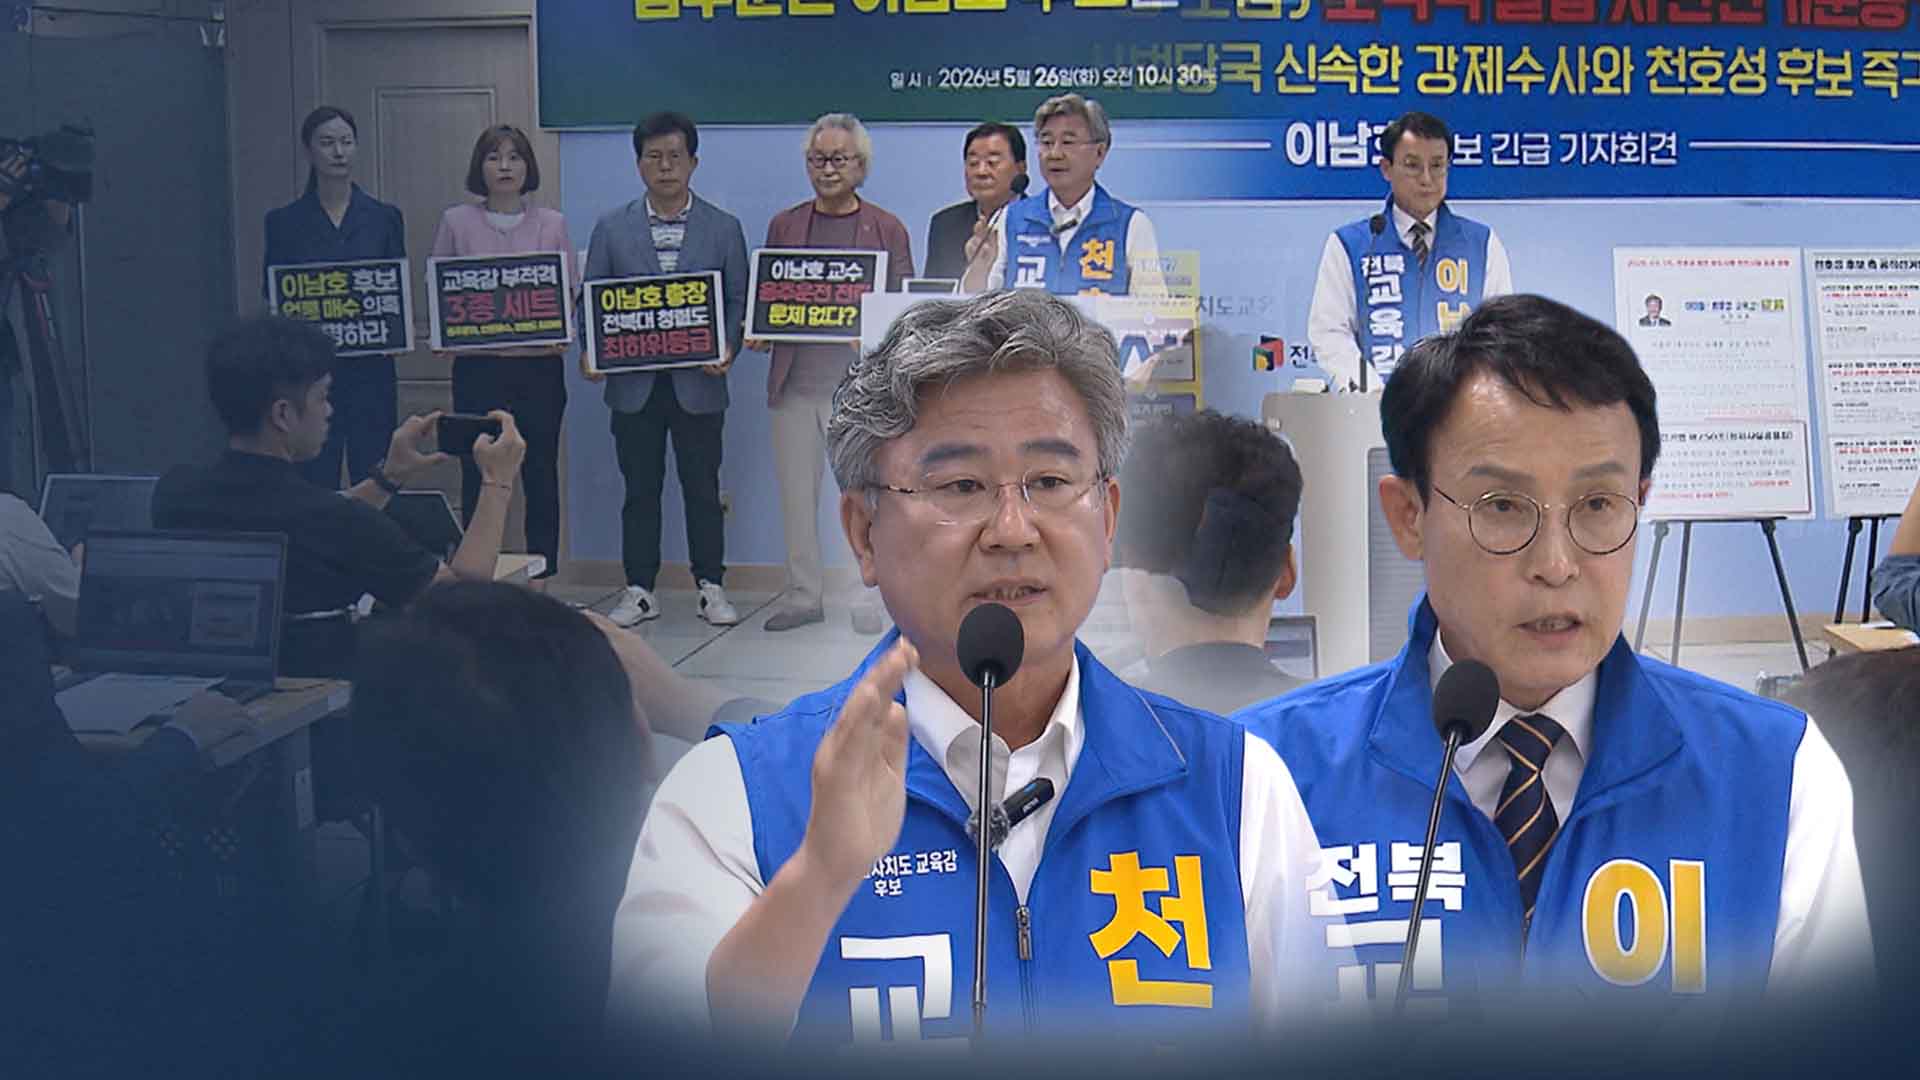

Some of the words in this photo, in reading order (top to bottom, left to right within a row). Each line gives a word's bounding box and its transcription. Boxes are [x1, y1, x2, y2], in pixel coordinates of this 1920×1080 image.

[938, 68, 1000, 87] 2026년
[1003, 67, 1030, 87] 5월
[1034, 66, 1099, 87] 26일(화)
[1102, 67, 1132, 87] 오전
[1136, 65, 1171, 86] 10시
[1274, 43, 1401, 94] 신속한
[1415, 44, 1635, 95] 강제수사와
[1645, 44, 1767, 96] 천호성
[1776, 47, 1854, 97] 후보
[1284, 119, 1386, 167] 이남
[1453, 133, 1485, 165] 보
[1490, 133, 1552, 166] 긴급
[1560, 132, 1677, 166] 기자회견
[771, 259, 825, 281] 이남호
[827, 259, 864, 282] 교수
[1014, 256, 1046, 289] 교
[1079, 238, 1115, 280] 천
[282, 271, 349, 298] 이남호
[352, 267, 399, 294] 후보
[442, 268, 500, 292] 교육감
[502, 289, 561, 319] 세트
[601, 284, 662, 312] 이남호
[768, 303, 806, 326] 문제
[808, 305, 858, 327] 없다?
[322, 319, 390, 346] 명하라
[915, 849, 958, 873] 교육감
[874, 878, 903, 897] 후보
[1305, 841, 1466, 917] 전북
[1089, 851, 1214, 1009] 천
[1581, 857, 1707, 995] 이
